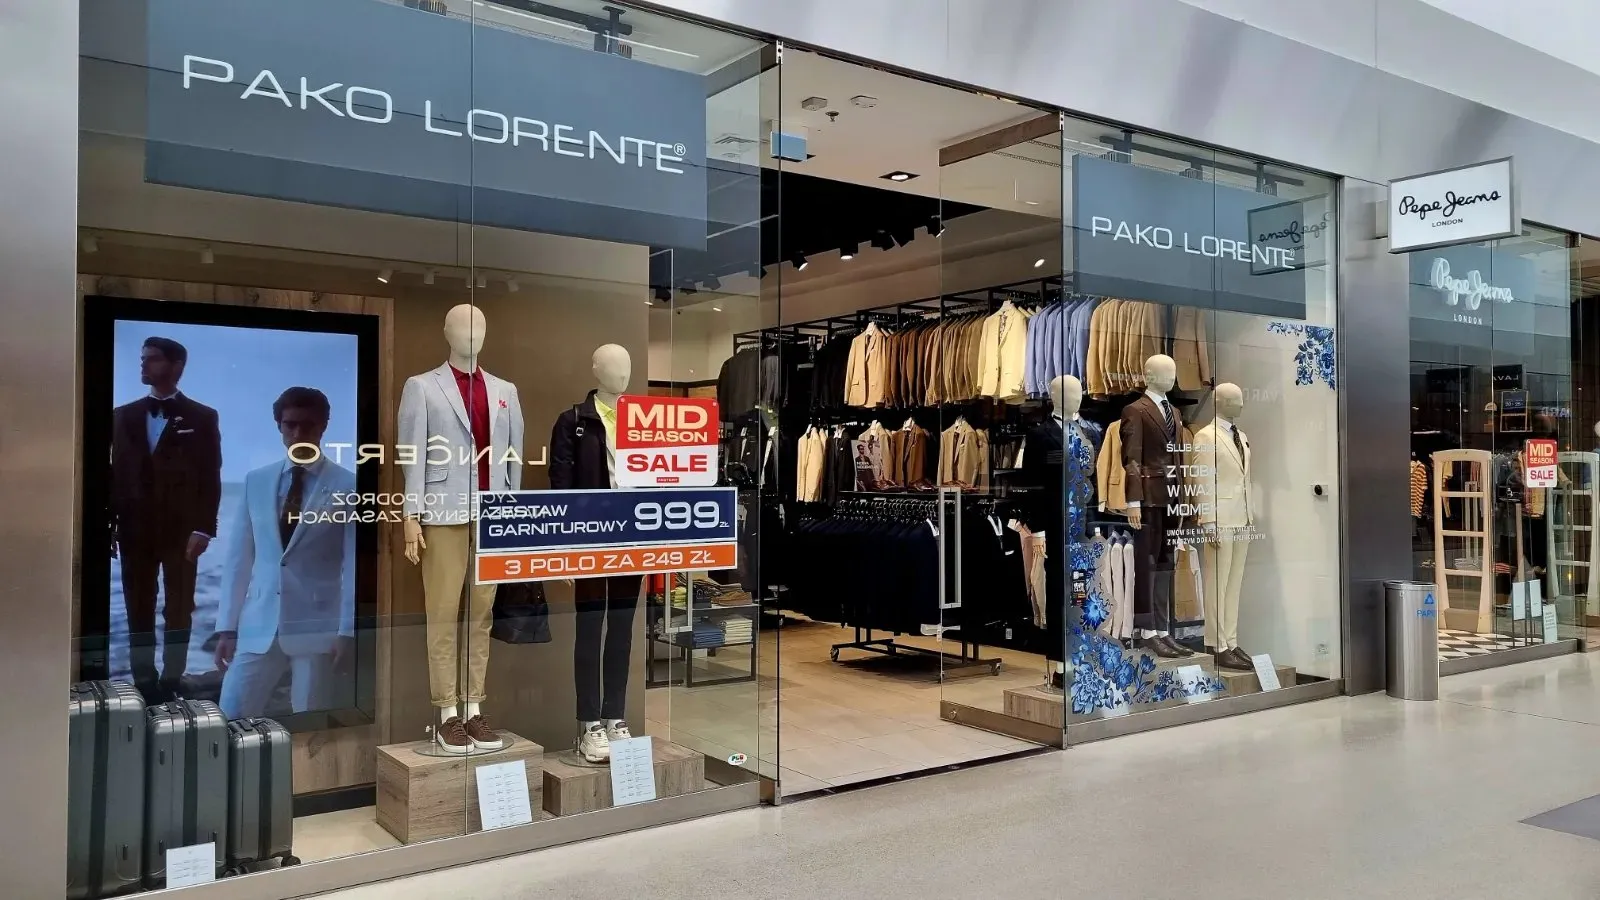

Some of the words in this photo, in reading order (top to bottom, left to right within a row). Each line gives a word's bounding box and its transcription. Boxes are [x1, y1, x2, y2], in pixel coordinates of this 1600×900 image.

[182, 54, 393, 124] PAKO
[1399, 195, 1442, 220] Pepe
[1442, 190, 1501, 217] Jeans
[1431, 218, 1463, 228] LONDON
[1091, 215, 1173, 250] PAKO
[1431, 257, 1472, 306] Pepe
[1466, 269, 1514, 310] Jeans
[1453, 313, 1483, 325] LONDON
[627, 402, 708, 430] MID
[627, 429, 708, 443] SEASON
[1166, 441, 1192, 452] ŚLUB
[1529, 443, 1554, 457] MID
[626, 453, 708, 473] SALE
[1166, 465, 1176, 478] Z
[1530, 470, 1554, 480] SALE
[1166, 485, 1180, 498] W
[488, 503, 568, 520] ZESTAW
[634, 501, 720, 531] 999
[488, 519, 628, 537] GARNITUROWY
[504, 559, 521, 575] 3
[530, 555, 596, 573] POLO
[604, 553, 635, 569] ZA
[642, 550, 684, 568] 249
[689, 549, 716, 565] ZŁ
